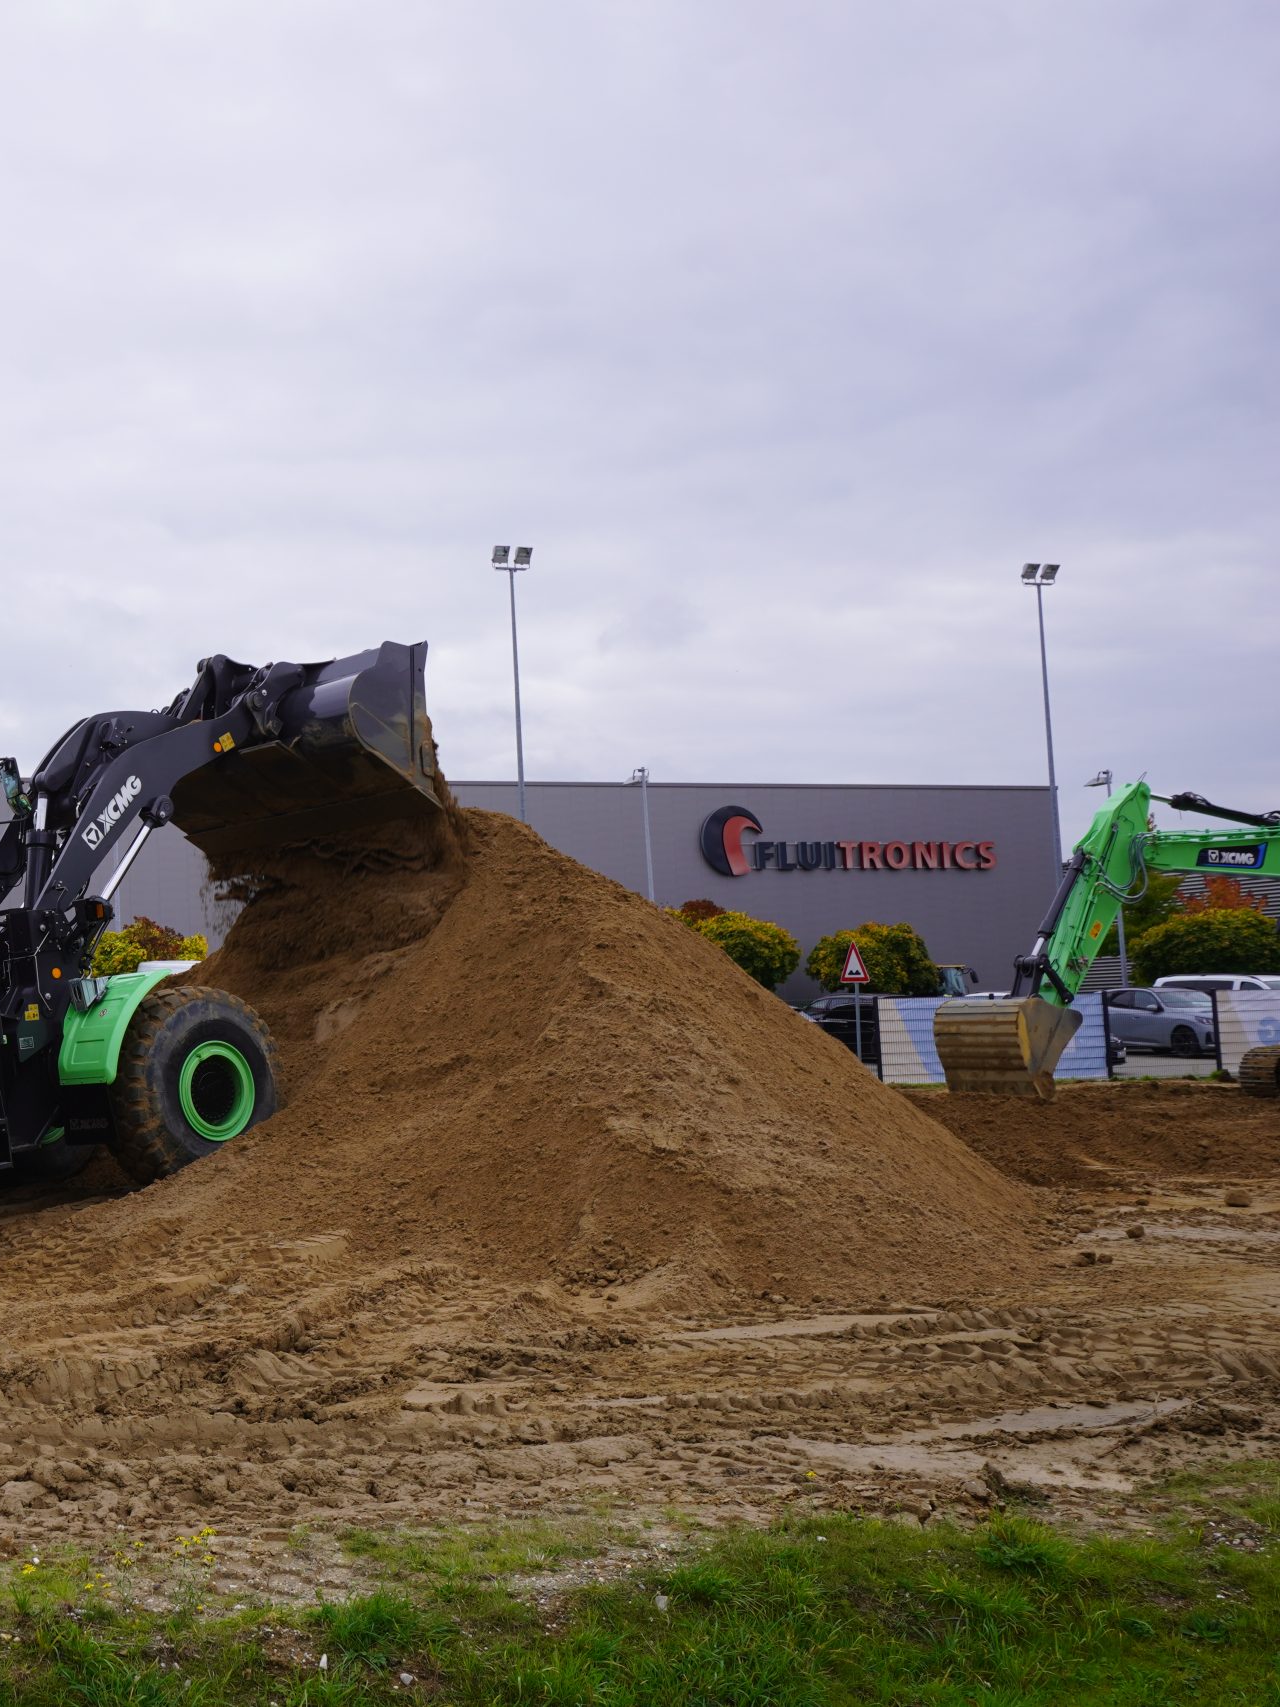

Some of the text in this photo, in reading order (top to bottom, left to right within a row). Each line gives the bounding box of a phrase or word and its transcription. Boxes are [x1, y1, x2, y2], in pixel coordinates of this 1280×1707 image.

[96, 775, 142, 836] XCMG
[754, 841, 997, 870] FLUITRONICS
[1220, 851, 1255, 865] XCMG
